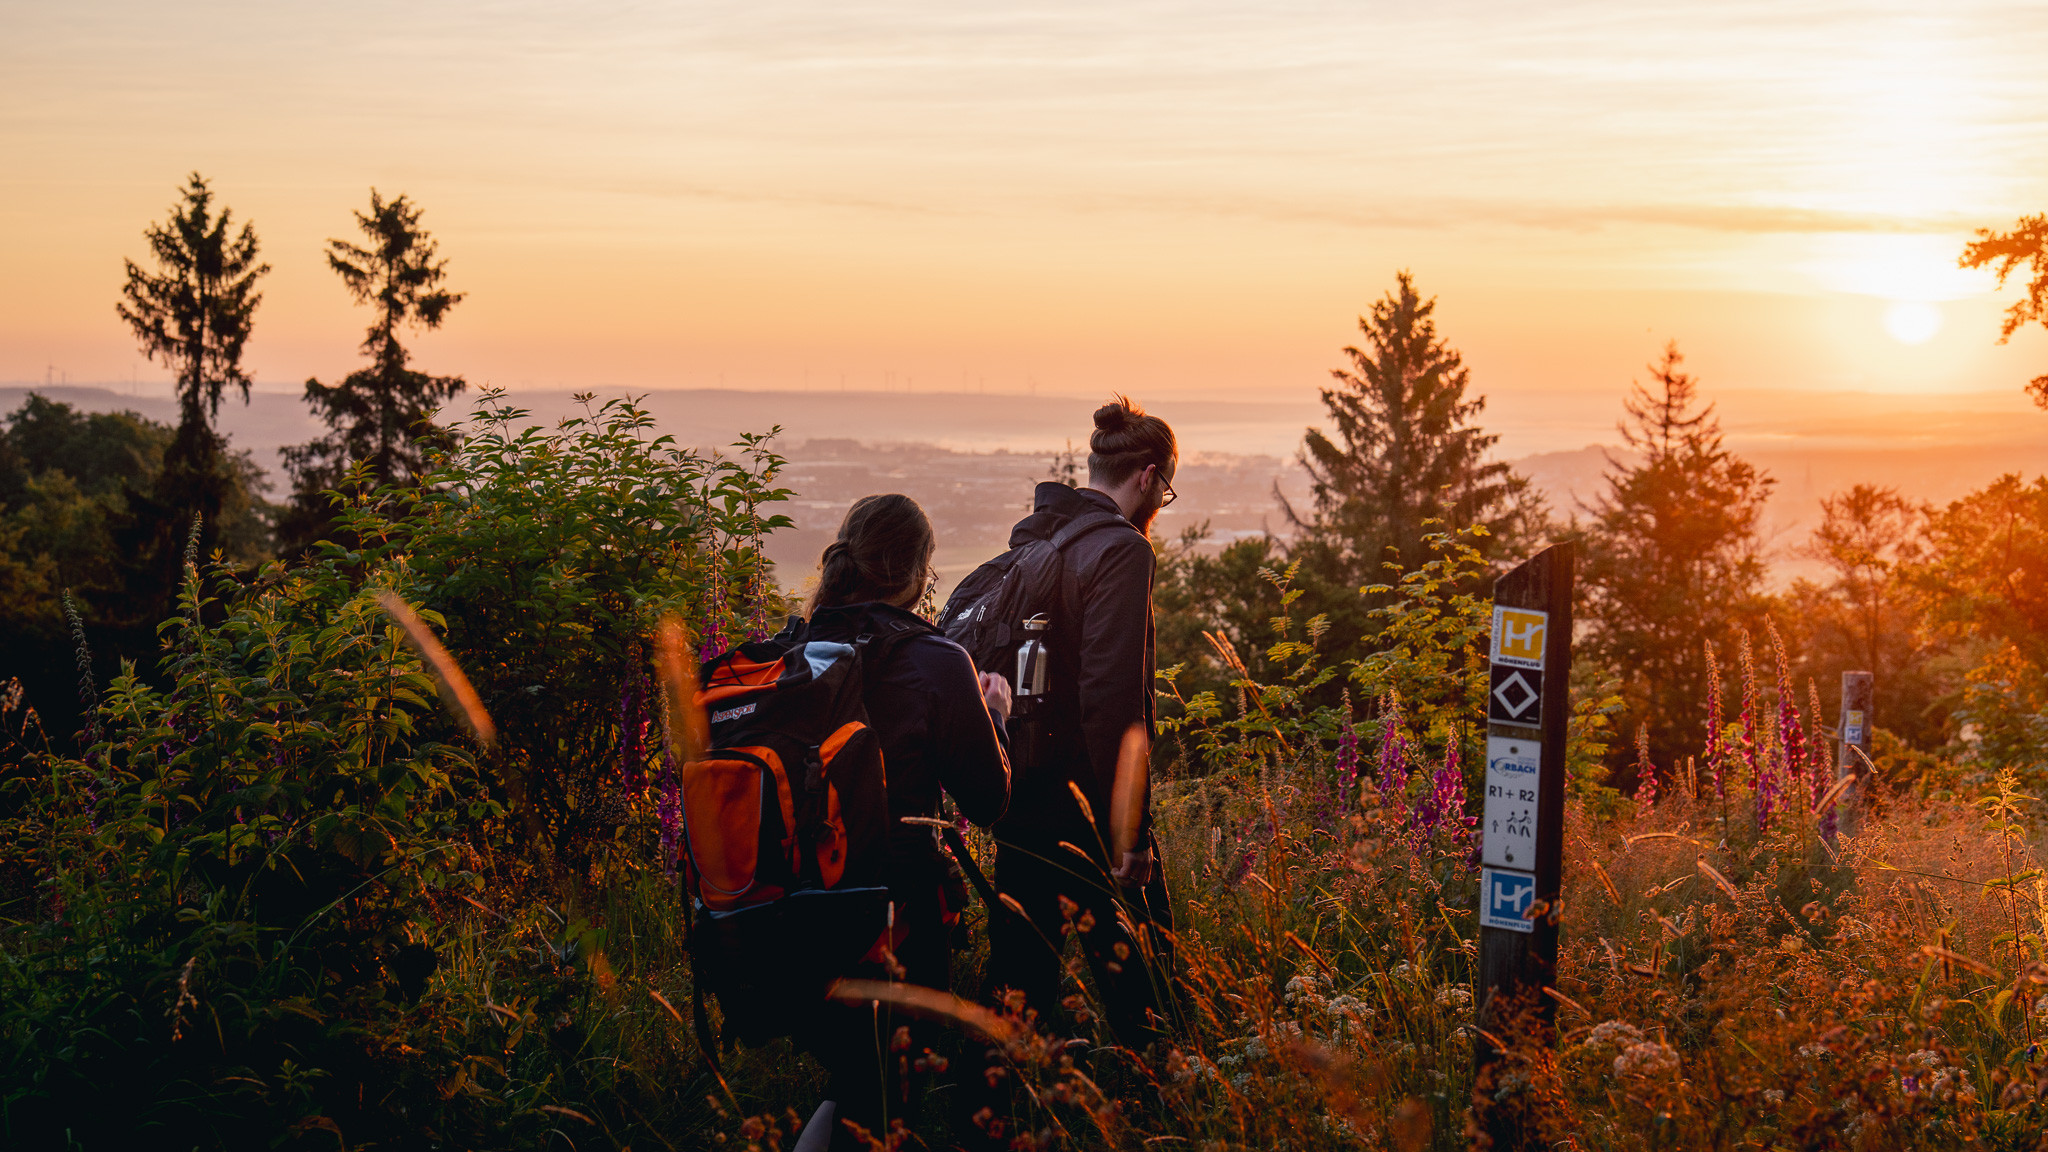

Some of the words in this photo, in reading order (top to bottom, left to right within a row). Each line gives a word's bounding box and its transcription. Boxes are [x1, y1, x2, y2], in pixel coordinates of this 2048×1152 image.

[1498, 656, 1540, 668] HÖHENFLUG
[712, 709, 733, 723] ASPEN
[732, 703, 756, 720] SPORT
[1489, 785, 1502, 798] R1
[1505, 789, 1514, 799] +
[1519, 789, 1535, 802] R2
